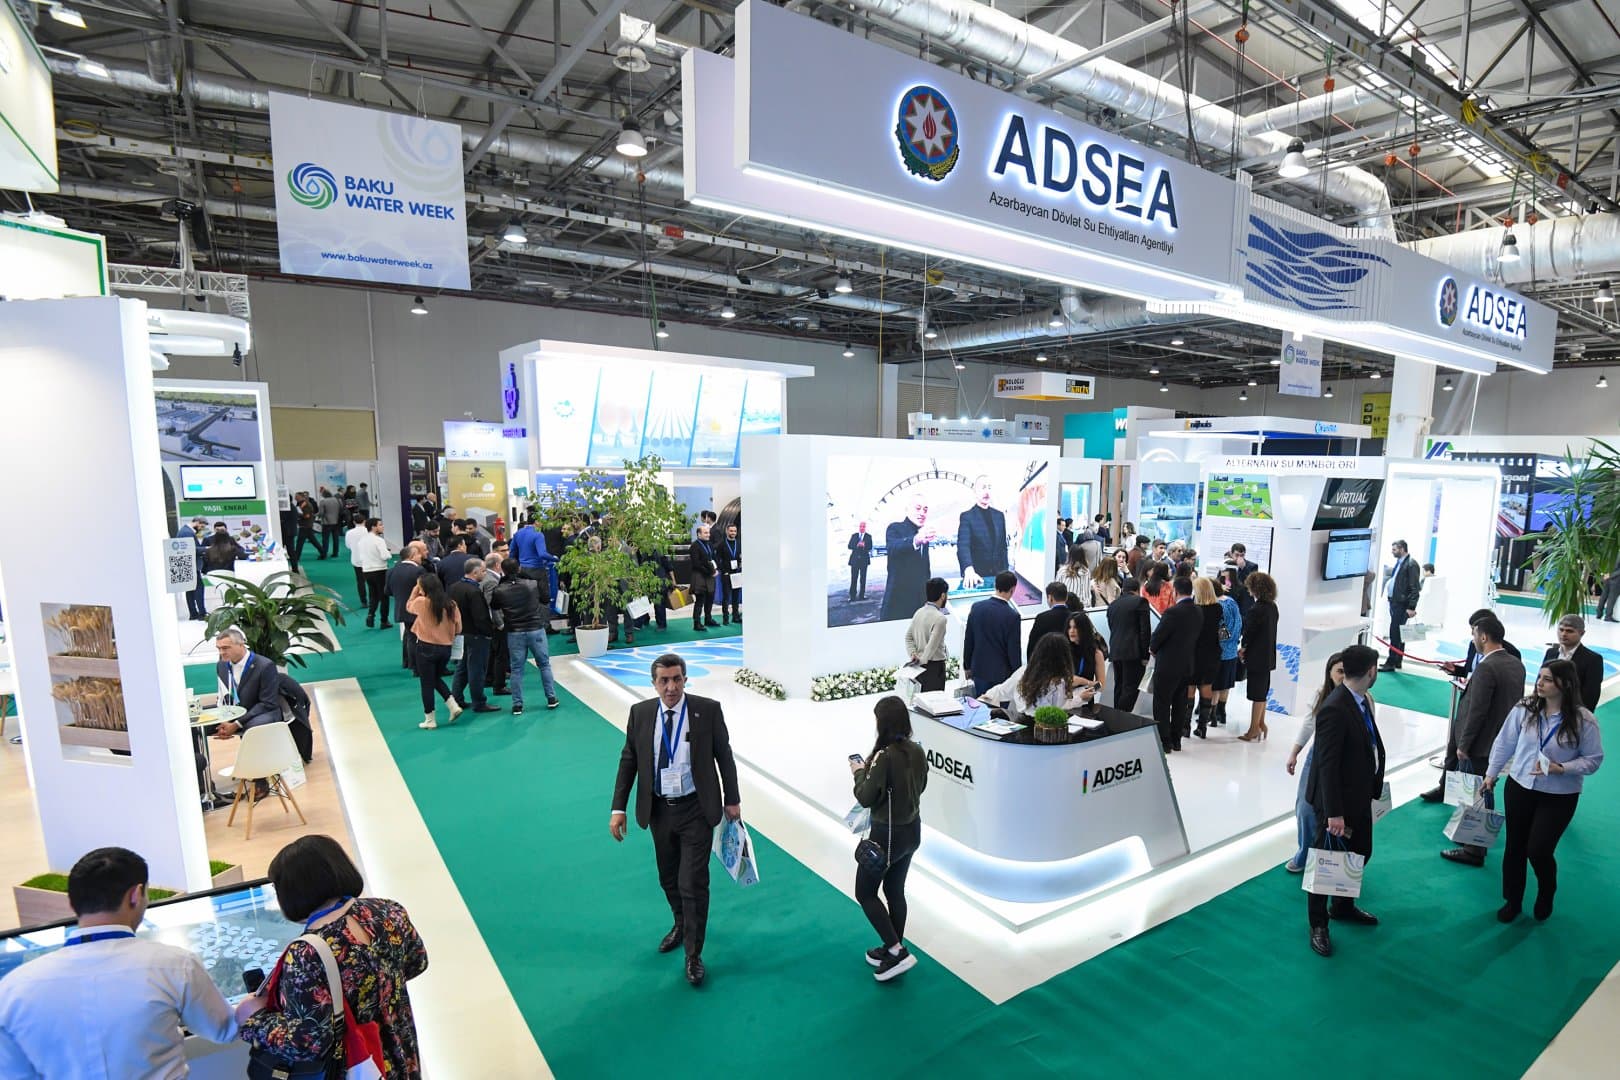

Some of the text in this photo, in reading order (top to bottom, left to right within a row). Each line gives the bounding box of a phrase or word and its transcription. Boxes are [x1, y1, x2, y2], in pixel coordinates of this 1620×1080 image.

[344, 175, 394, 196] BAKU
[993, 114, 1179, 229] ADSEA
[345, 193, 456, 221] WATER WEEK
[989, 191, 1175, 255] Azərbaycan Dövlət Su Ehtiyatları Agentliyi
[320, 251, 433, 270] www.bakuwaterweek.az
[1467, 286, 1527, 338] ADSEA
[1281, 459, 1294, 469] SU
[1339, 507, 1355, 518] TUR
[926, 749, 973, 784] ADSEA
[1092, 758, 1143, 788] ADSEA
